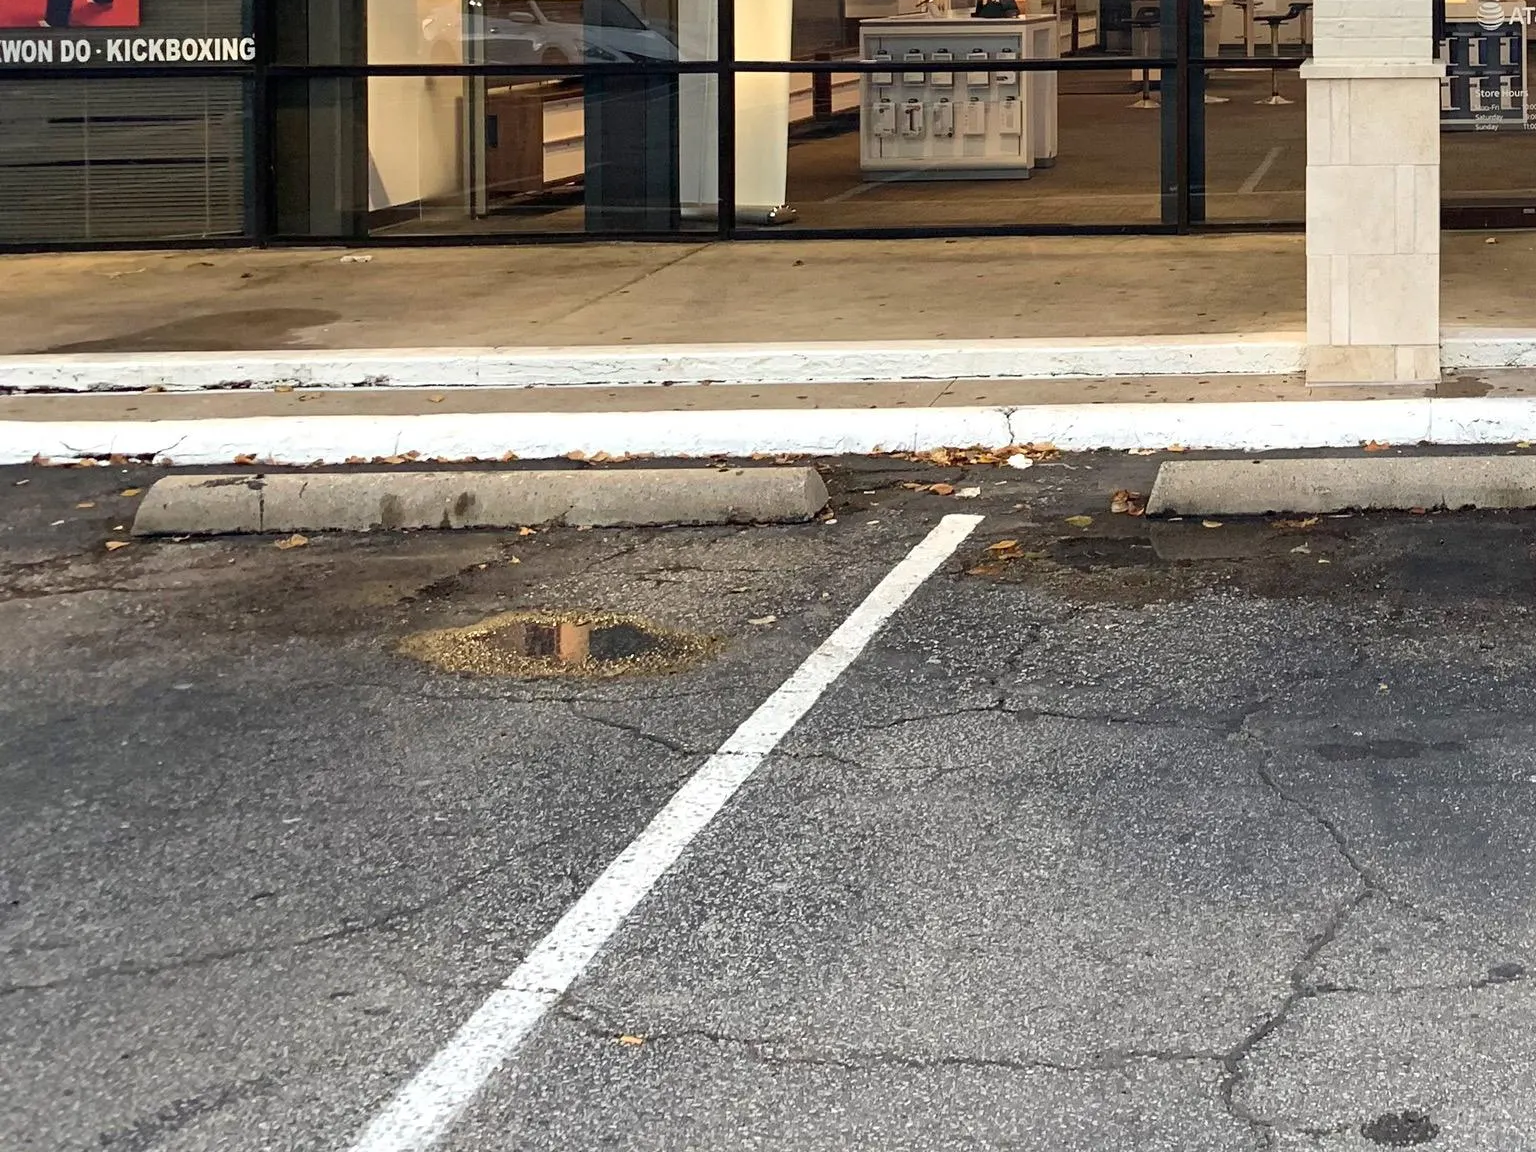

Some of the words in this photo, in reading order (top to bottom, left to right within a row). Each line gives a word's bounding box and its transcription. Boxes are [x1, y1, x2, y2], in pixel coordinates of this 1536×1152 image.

[0, 39, 53, 63] WON
[60, 39, 91, 63] DO
[107, 38, 256, 62] KICKBOXING
[1475, 89, 1500, 98] Store
[1501, 89, 1529, 97] Hours
[1475, 123, 1499, 132] Sunday
